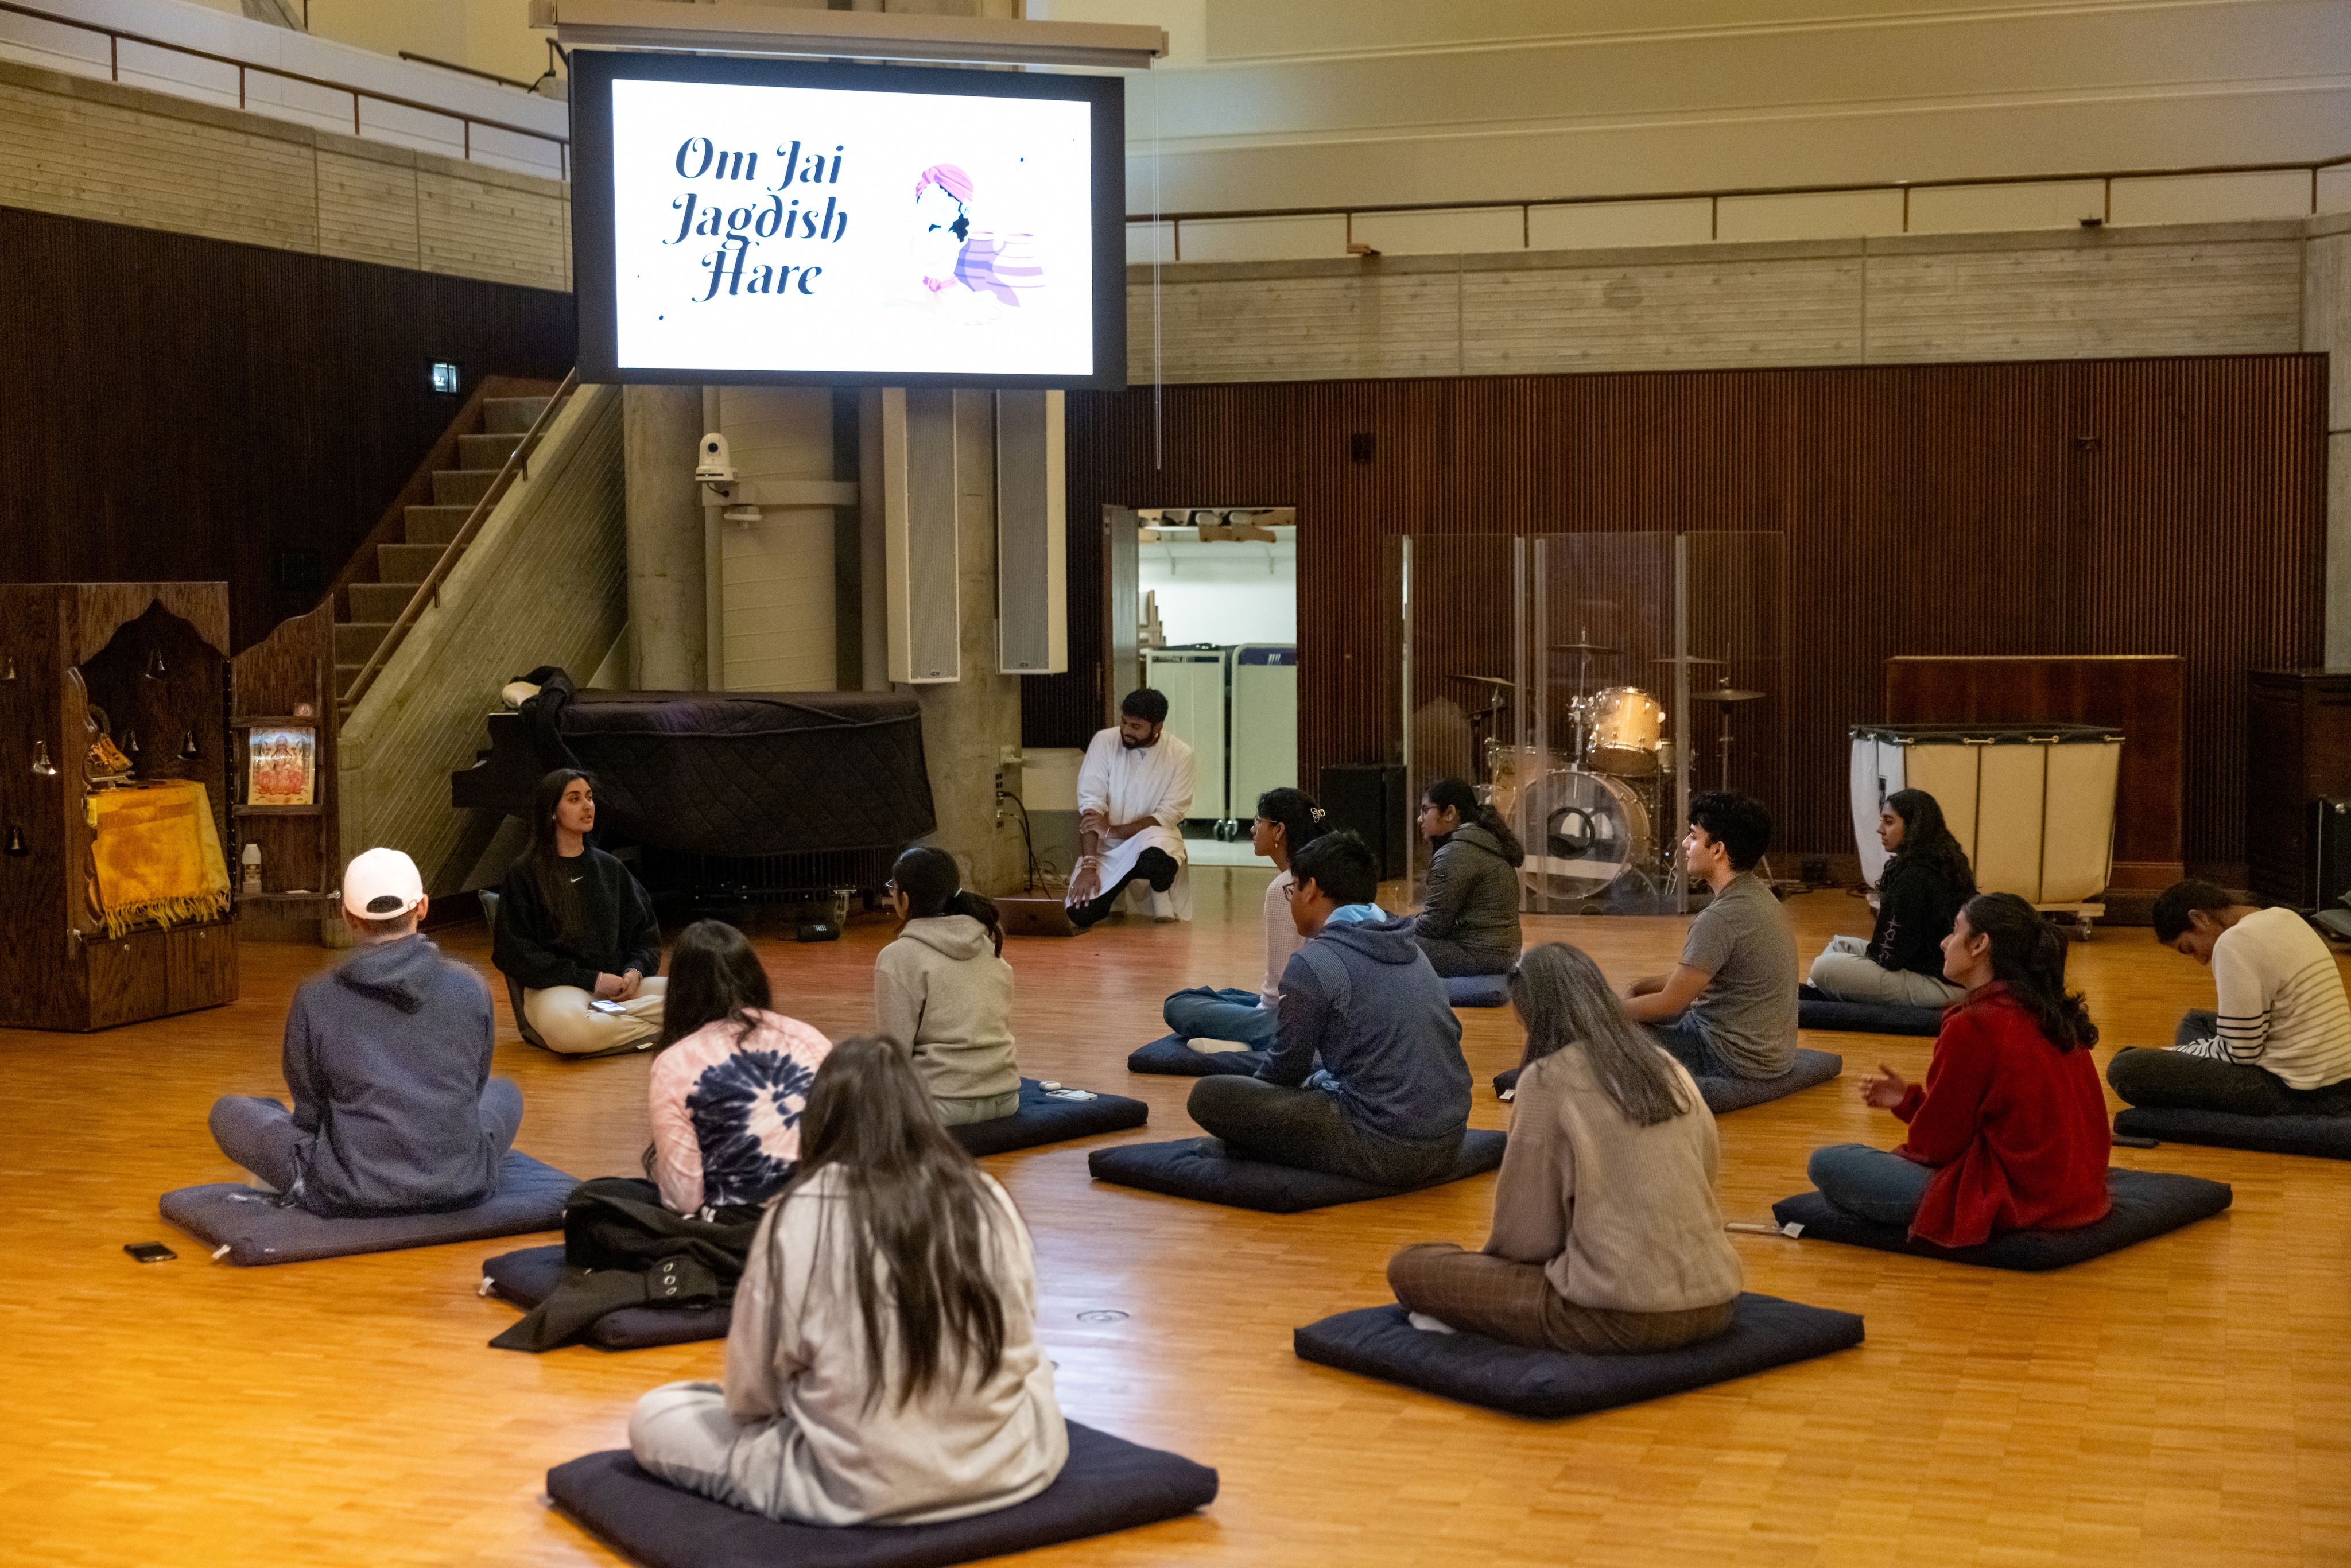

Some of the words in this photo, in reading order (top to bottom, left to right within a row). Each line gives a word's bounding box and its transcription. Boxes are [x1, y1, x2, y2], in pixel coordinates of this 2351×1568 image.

[676, 137, 758, 180] Om
[766, 141, 844, 192] Jai
[662, 193, 848, 250] Jagdish
[691, 241, 823, 302] Hare
